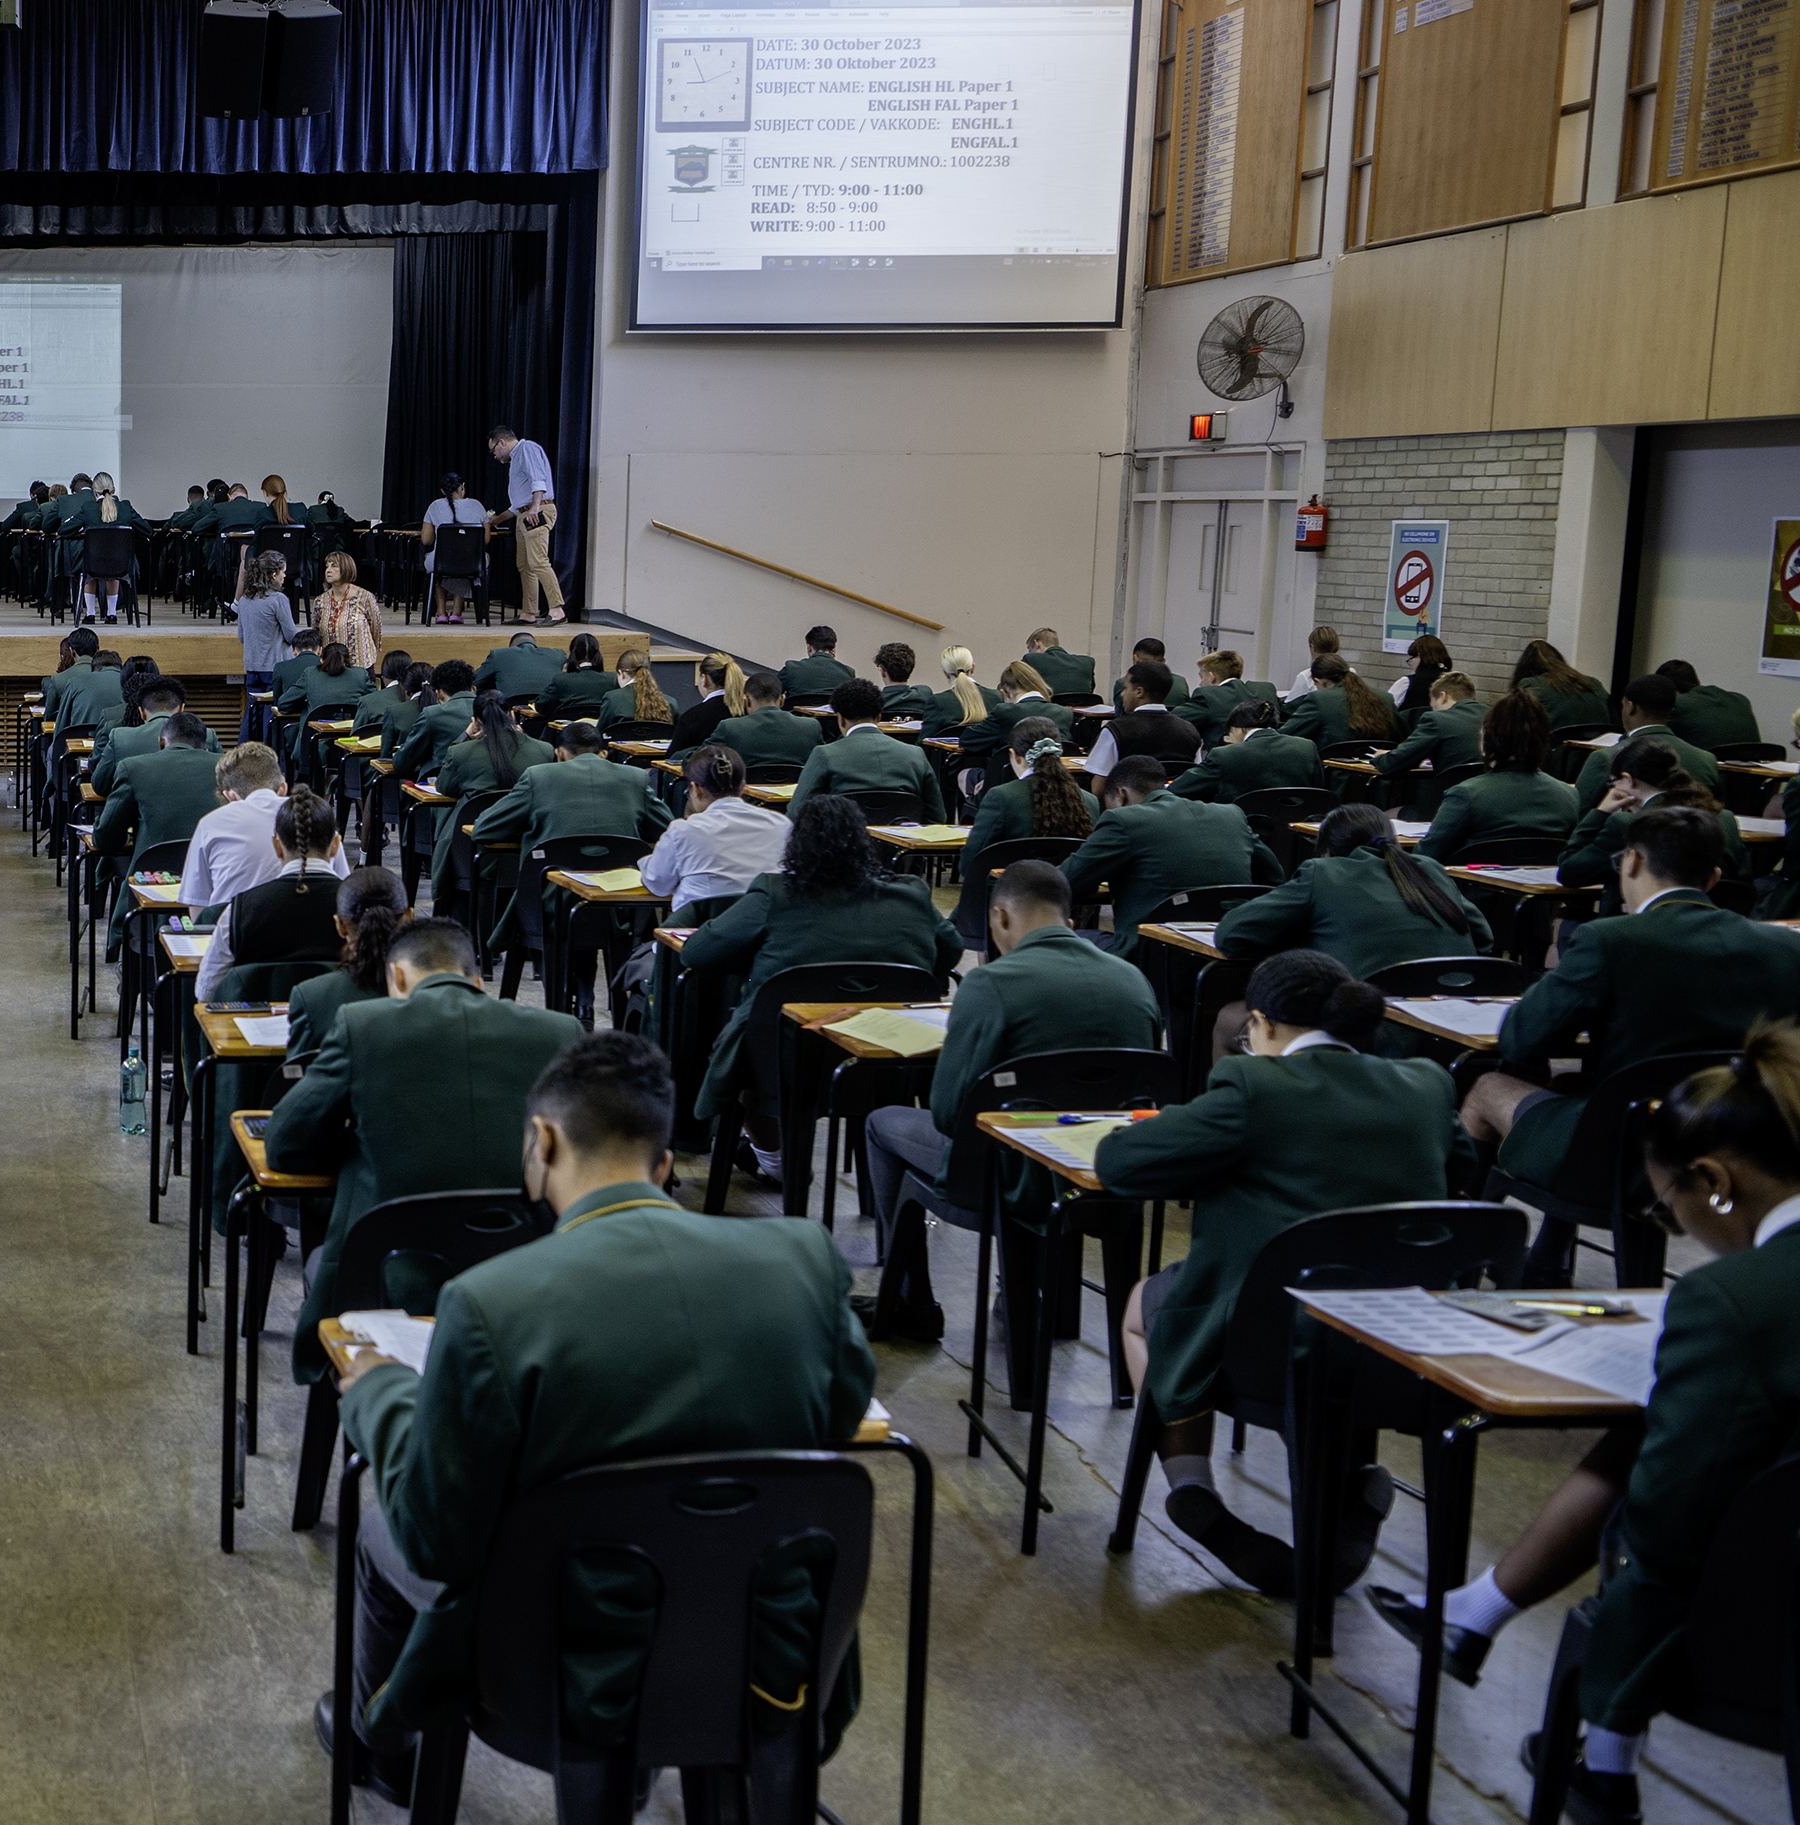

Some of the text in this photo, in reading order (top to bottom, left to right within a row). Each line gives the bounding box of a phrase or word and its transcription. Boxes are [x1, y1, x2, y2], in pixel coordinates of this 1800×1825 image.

[702, 44, 711, 52] 12
[756, 38, 921, 51] DATE: 30 October 2023
[756, 57, 936, 70] DATUM: 30 Oktober 2023
[755, 80, 1013, 96] SUBJECT NAME: ENGLISH HL Paper 1
[718, 105, 723, 113] 5
[868, 99, 1018, 114] ENGLISH FAL Paper 1
[754, 118, 1013, 134] SUBJECT CODE VAKKODE: ENGHL.1
[951, 137, 1018, 148] ENGFAL.1
[753, 155, 1010, 169] CENTRE NR. SENTRUMNO.: 1002238
[752, 184, 924, 196] TIME TYD: 9:00 11:00
[751, 202, 878, 214] READ: 8:50 9:00
[750, 220, 886, 232] WRITE: 9:00 11:00
[16, 347, 23, 357] 1
[22, 363, 28, 373] 1
[1194, 416, 1210, 439] UIT
